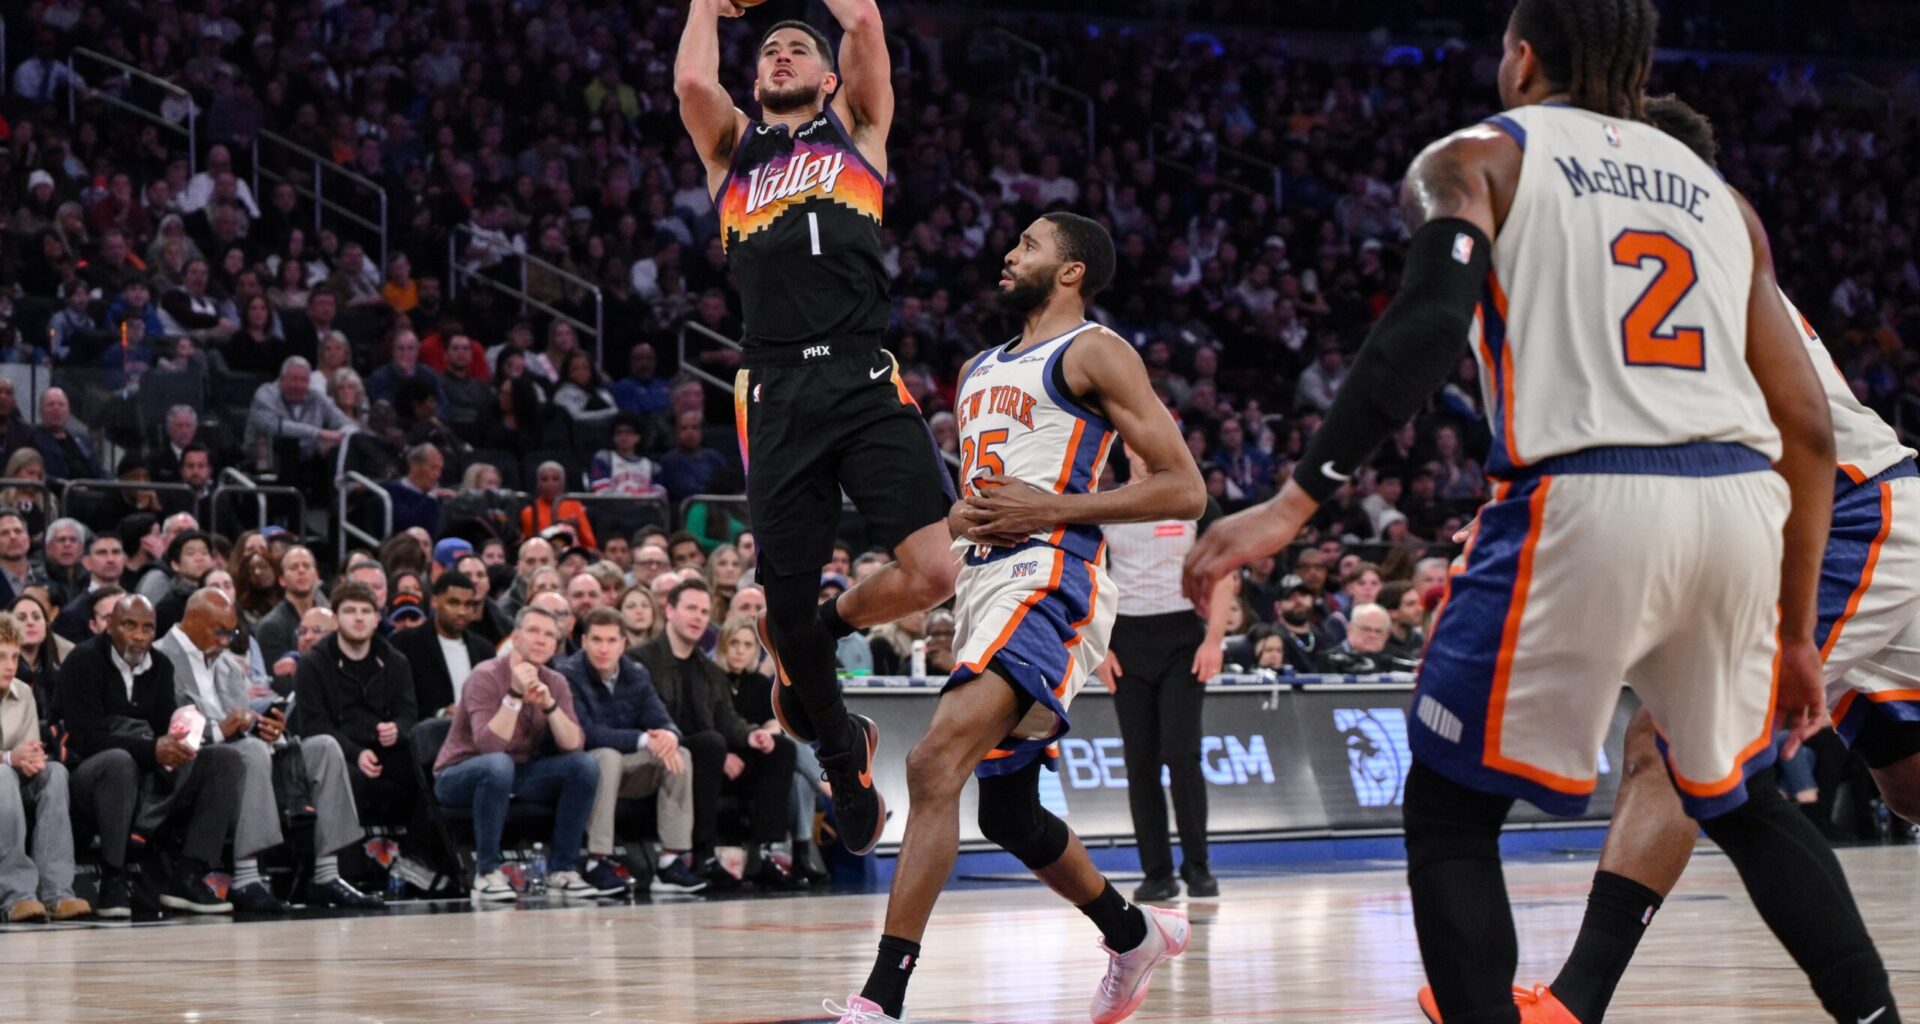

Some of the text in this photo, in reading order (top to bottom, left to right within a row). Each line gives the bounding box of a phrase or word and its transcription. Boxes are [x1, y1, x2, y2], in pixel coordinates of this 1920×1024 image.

[799, 117, 827, 138] PayPal
[746, 151, 845, 214] Valley
[1554, 156, 1710, 223] McBRIDE
[807, 212, 821, 255] 1
[1610, 227, 1705, 372] 2
[802, 345, 831, 359] PHX
[988, 385, 1038, 432] YORK
[961, 428, 1010, 498] 25
[1010, 560, 1038, 579] NYC
[1060, 735, 1275, 790] BEGM
